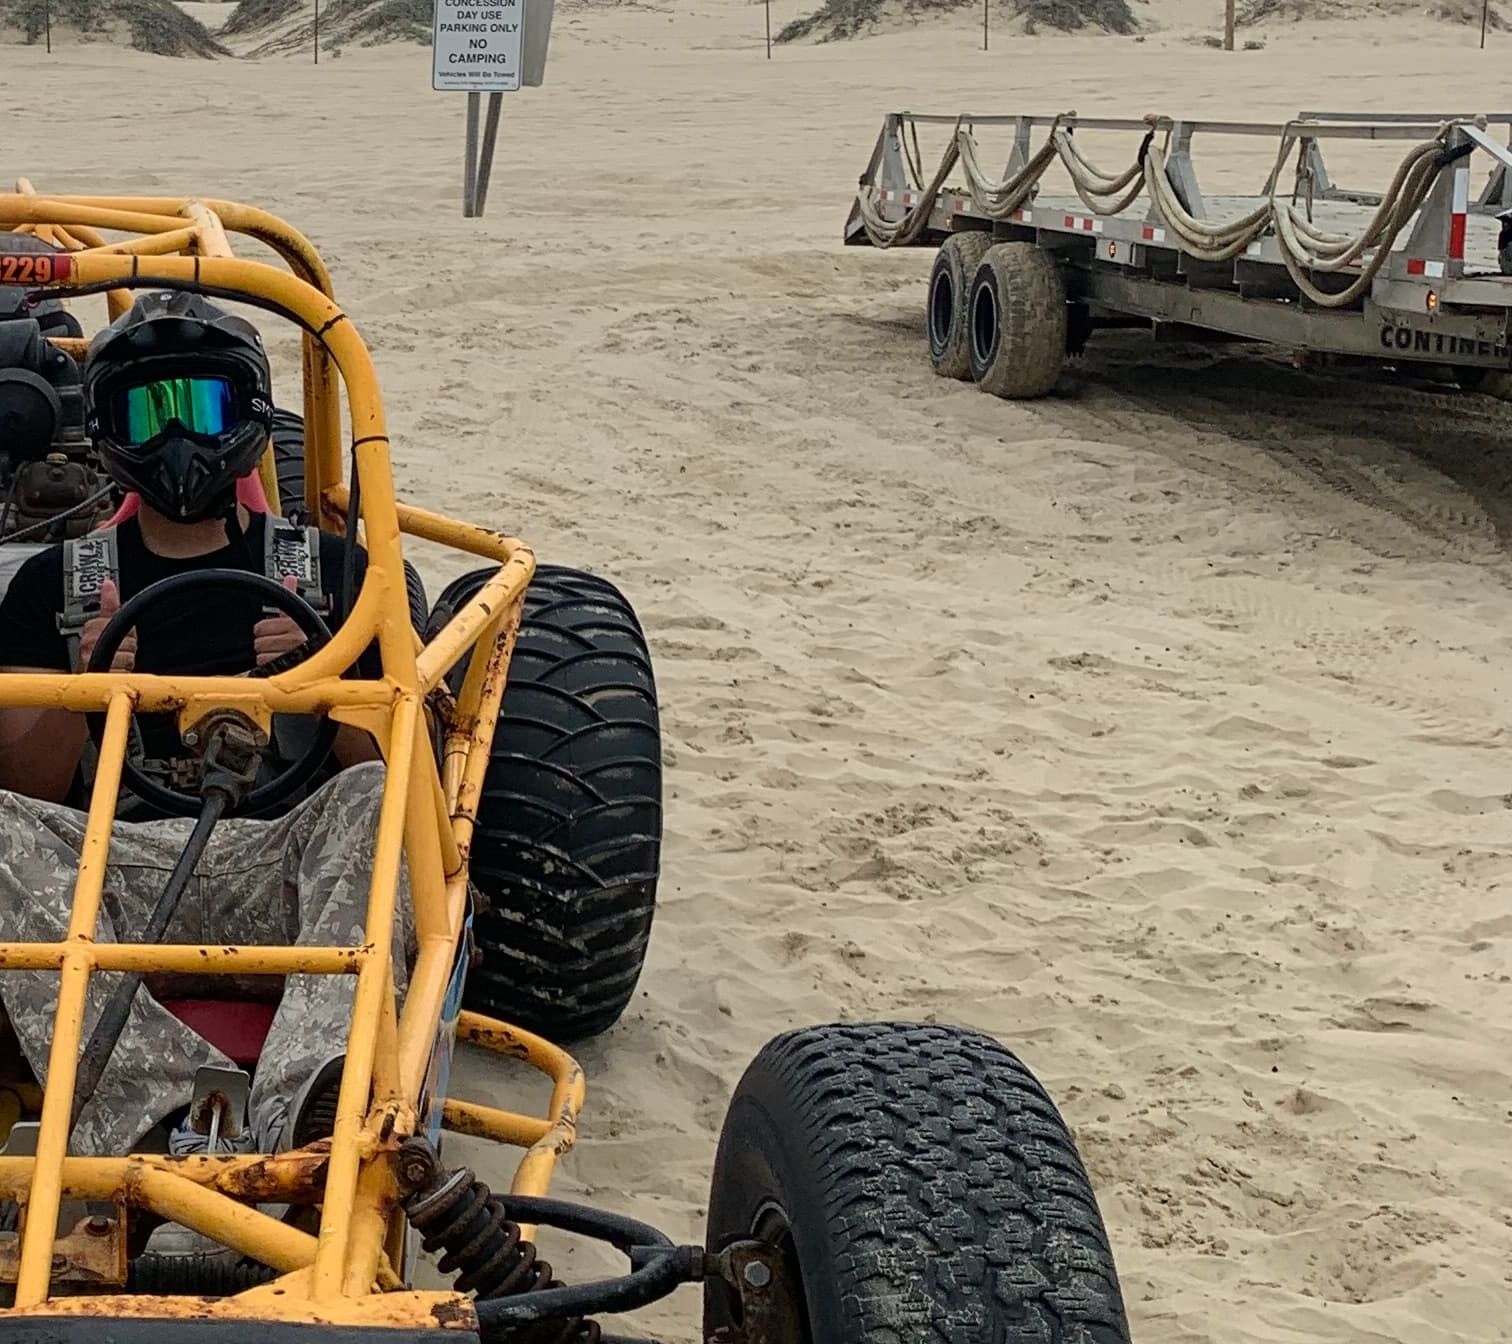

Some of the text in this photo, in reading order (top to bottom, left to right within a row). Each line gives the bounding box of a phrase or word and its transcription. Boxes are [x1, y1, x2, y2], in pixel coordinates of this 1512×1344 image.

[456, 10, 503, 20] DAY USE
[439, 23, 519, 33] PARKING ONLY
[468, 38, 488, 49] NO
[448, 53, 507, 64] CAMPING
